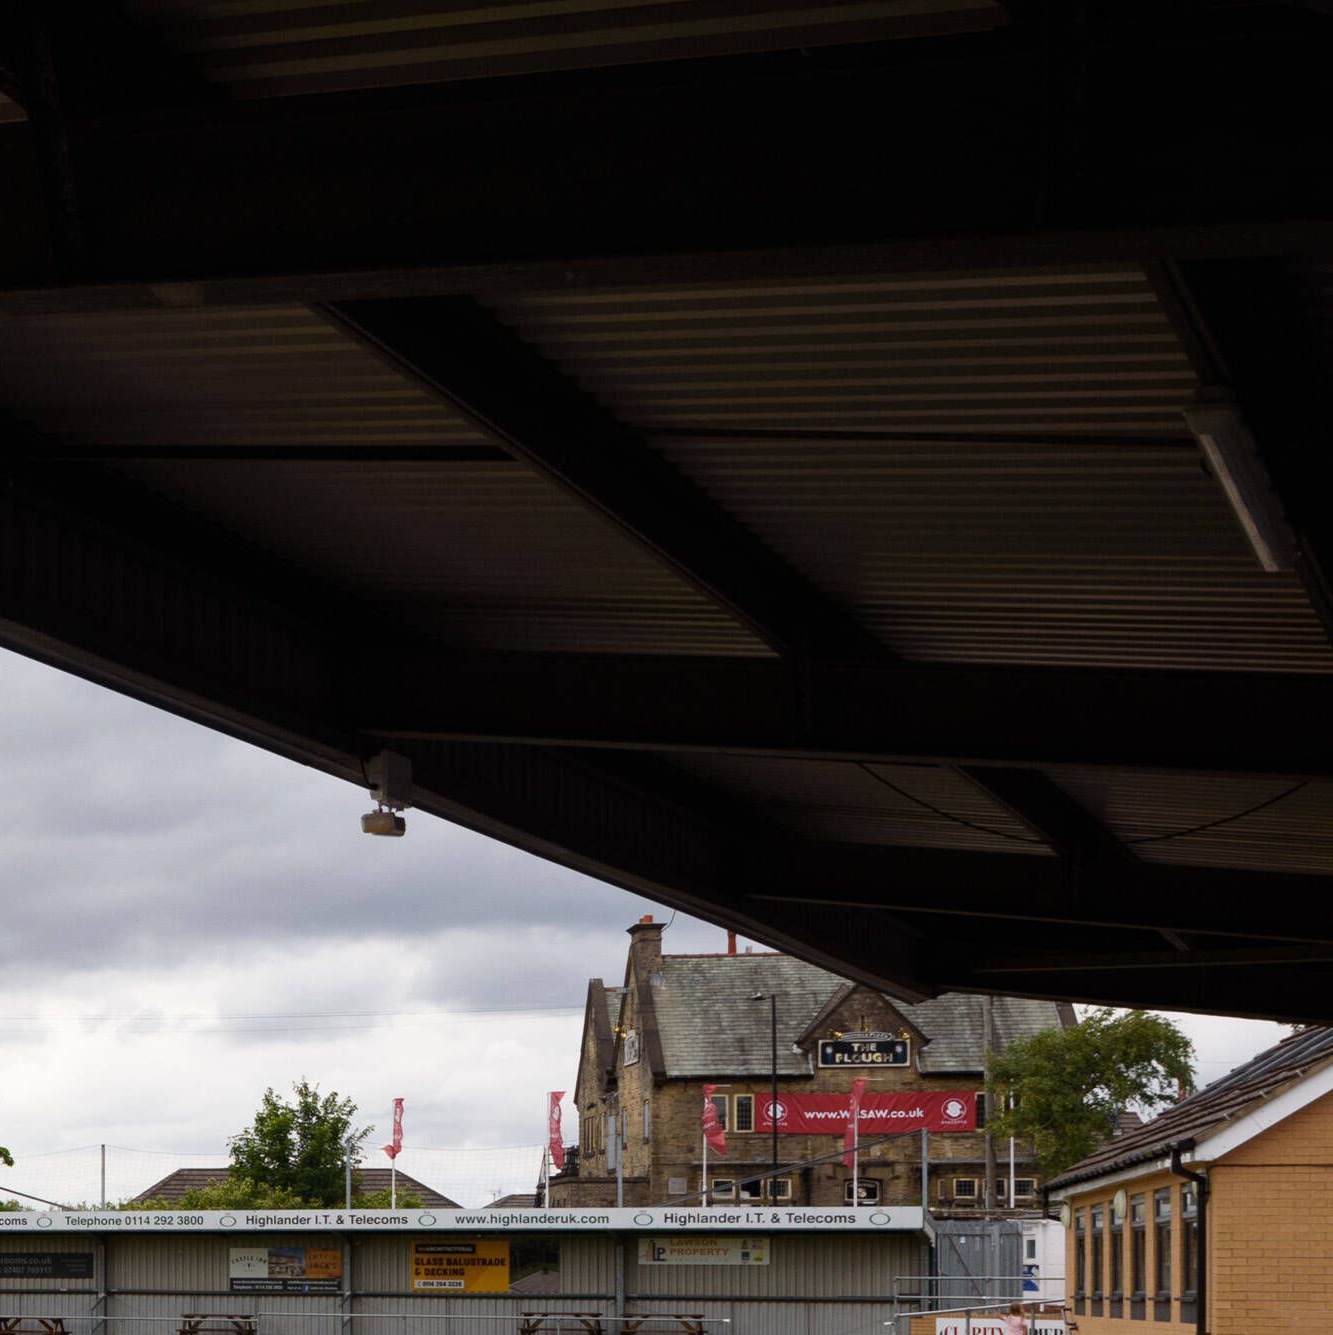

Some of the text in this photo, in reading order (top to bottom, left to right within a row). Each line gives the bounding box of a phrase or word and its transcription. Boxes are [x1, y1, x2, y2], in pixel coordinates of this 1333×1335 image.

[851, 1042, 877, 1052] THE
[835, 1053, 893, 1063] PLOUGH
[65, 1215, 204, 1228] Telephone 0114 292 3800
[245, 1214, 311, 1227] Highlander
[335, 1215, 345, 1225] &
[349, 1214, 408, 1225] Telecoms
[455, 1213, 610, 1226] www.highlanderuk.com
[664, 1212, 741, 1226] Highlander
[770, 1213, 781, 1224] &
[785, 1212, 856, 1224] Telecoms
[669, 1238, 718, 1246] LAWSON
[669, 1247, 730, 1256] PROPERTY
[414, 1257, 506, 1266] GLASS BALUSTRADE
[414, 1268, 466, 1276] & DECKING
